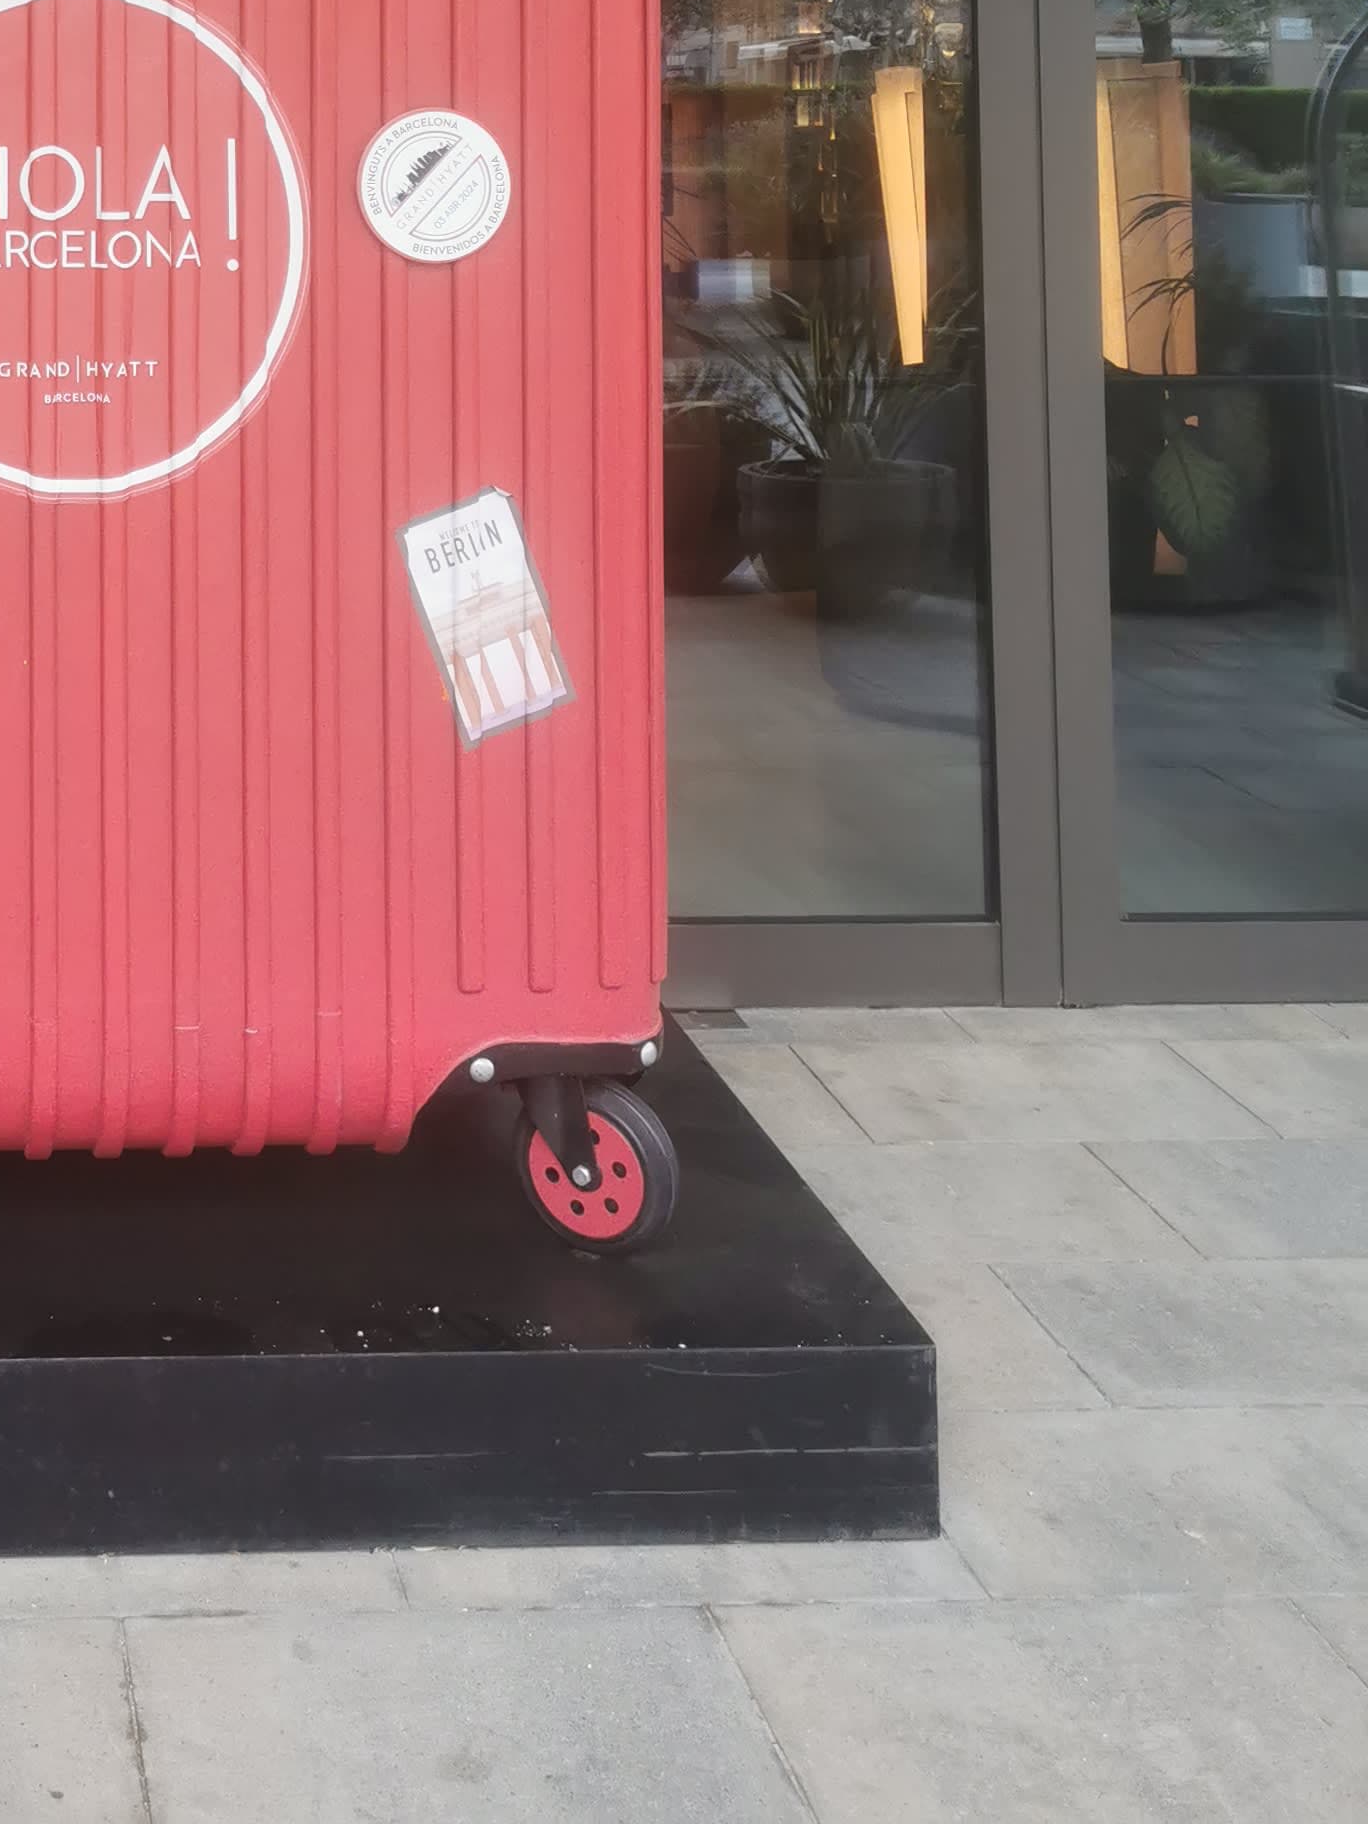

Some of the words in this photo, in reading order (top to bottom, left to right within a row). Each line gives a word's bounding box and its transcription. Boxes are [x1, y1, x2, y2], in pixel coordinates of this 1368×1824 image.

[367, 144, 387, 216] BENVINGUTS
[392, 116, 459, 139] BARCELONA
[395, 188, 436, 231] GRAND
[438, 142, 474, 184] HYATT
[412, 230, 486, 256] BIENVENIDOS
[487, 155, 506, 225] BARCELONA
[43, 392, 111, 404] BARCELONA
[85, 360, 159, 378] HYATT
[423, 519, 504, 574] BERLIN
